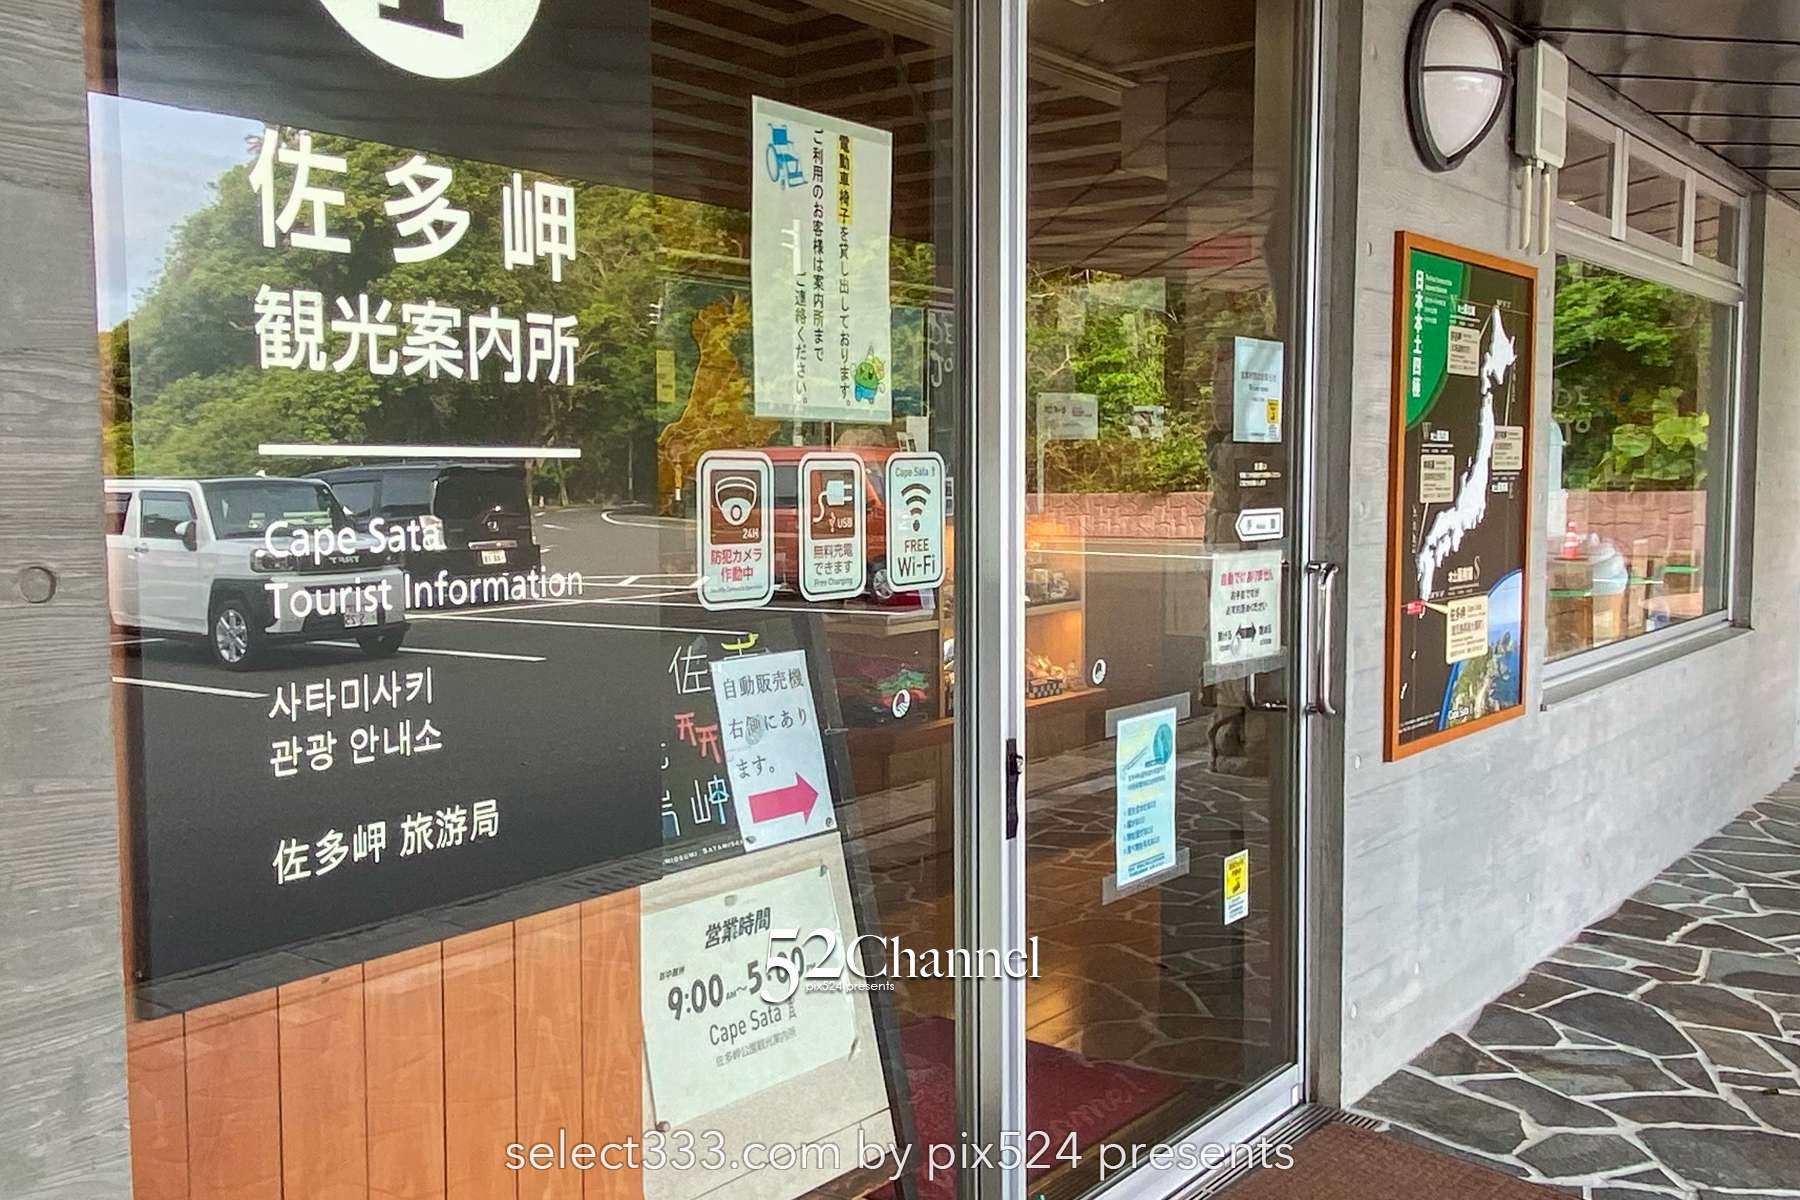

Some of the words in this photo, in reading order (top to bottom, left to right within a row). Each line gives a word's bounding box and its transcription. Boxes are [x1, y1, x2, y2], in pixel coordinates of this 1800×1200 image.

[249, 127, 576, 282] 佐多岬
[812, 128, 824, 362] ご利用のお客様は案内所まで
[838, 134, 851, 406] 電動車椅子を貸し出しております。
[254, 284, 579, 386] 観光案内所
[795, 271, 808, 404] ご連絡ください。
[914, 466, 930, 477] Sata
[265, 521, 356, 566] Cape
[370, 518, 446, 554] Sata
[742, 527, 760, 539] 24H
[837, 518, 853, 529] USB
[711, 549, 762, 566] 防犯カメラ
[813, 543, 853, 560] 無料充電
[904, 538, 929, 551] FREE
[720, 566, 754, 583] 作動中
[813, 560, 853, 575] できます
[897, 554, 936, 578] Wi-Fi
[265, 576, 393, 620] Tourist
[404, 566, 583, 608] Information
[668, 645, 711, 695] 佐
[723, 668, 804, 700] 自動販売機
[269, 667, 433, 722] 사타미사키
[729, 708, 807, 739] 右側にあり
[270, 730, 338, 777] 관광
[351, 718, 443, 765] 안내소
[736, 755, 775, 778] ます。
[272, 822, 386, 884] 佐多岬
[399, 799, 500, 857] 旅游局
[705, 906, 771, 949] 営業時間
[668, 973, 724, 1020] 9:00
[709, 1020, 746, 1045] Cape
[751, 1005, 782, 1030] Sata
